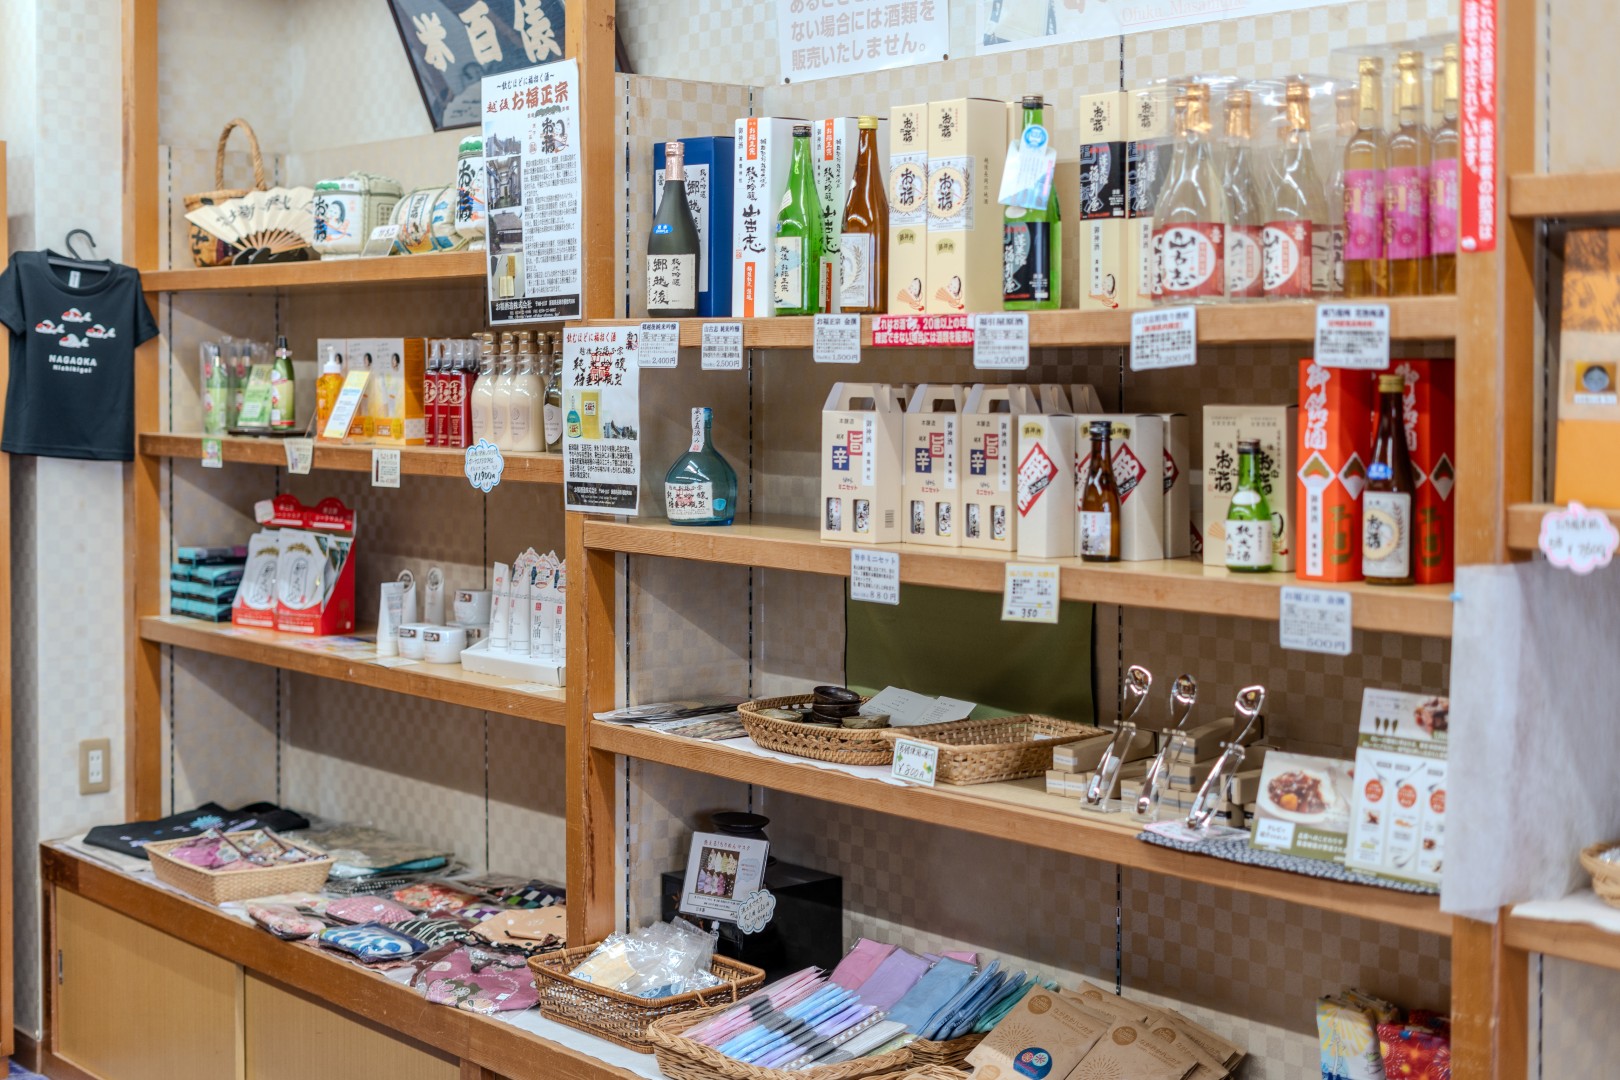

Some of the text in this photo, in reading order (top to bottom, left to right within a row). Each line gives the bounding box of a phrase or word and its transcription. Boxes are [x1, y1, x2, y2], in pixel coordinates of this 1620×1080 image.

[791, 0, 935, 41] ない場合には酒類を
[792, 32, 926, 71] 販売いたしません。
[511, 81, 568, 110] お福正宗
[746, 166, 758, 200] 純米吟醸
[742, 204, 766, 253] 山古志
[652, 258, 669, 305] 郷越後
[874, 316, 976, 333] れはお酒です。20歳以上の年
[48, 354, 97, 367] NAGAOKA
[652, 356, 676, 365] 2,400円
[716, 360, 740, 368] 2,500円
[994, 356, 1025, 365] 2,000円
[1305, 363, 1331, 450] 御銘酒
[849, 432, 862, 454] 旨
[931, 434, 944, 456] 旨
[986, 435, 998, 457] 旨
[833, 447, 849, 469] 辛
[917, 449, 931, 472] 辛
[971, 451, 985, 474] 辛
[1215, 450, 1233, 493] お福
[870, 591, 896, 601] 880円
[1021, 608, 1038, 618] 350
